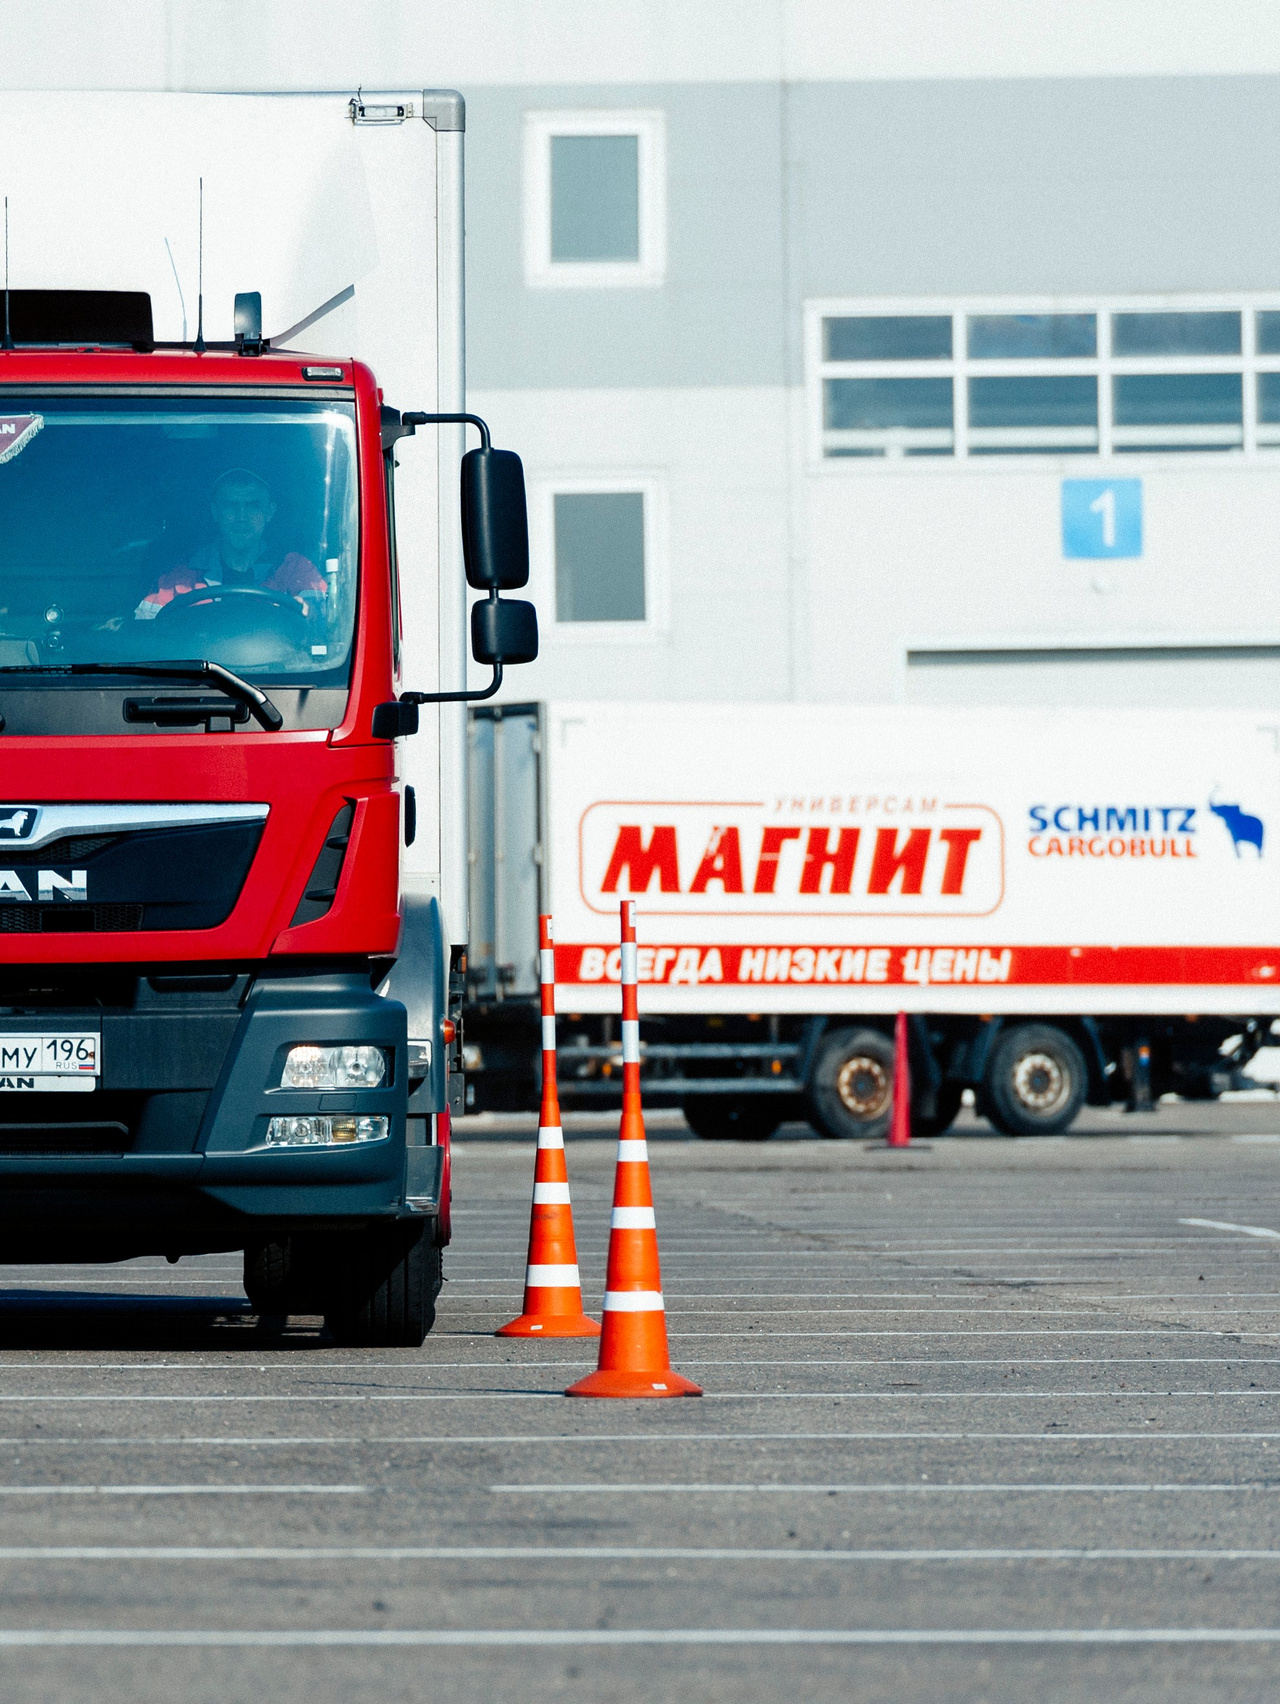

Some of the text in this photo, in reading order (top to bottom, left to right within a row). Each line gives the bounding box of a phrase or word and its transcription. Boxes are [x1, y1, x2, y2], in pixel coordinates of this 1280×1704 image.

[1090, 489, 1116, 547] 1
[1029, 806, 1196, 832] SCHMITZ
[600, 825, 982, 895] МАГНИТ
[1027, 836, 1197, 858] CARGOBULL
[738, 947, 890, 982] НИЗКИЕ
[901, 948, 1012, 985] ЦЕНЫ
[46, 1039, 89, 1061] 196
[56, 1062, 77, 1070] RUS
